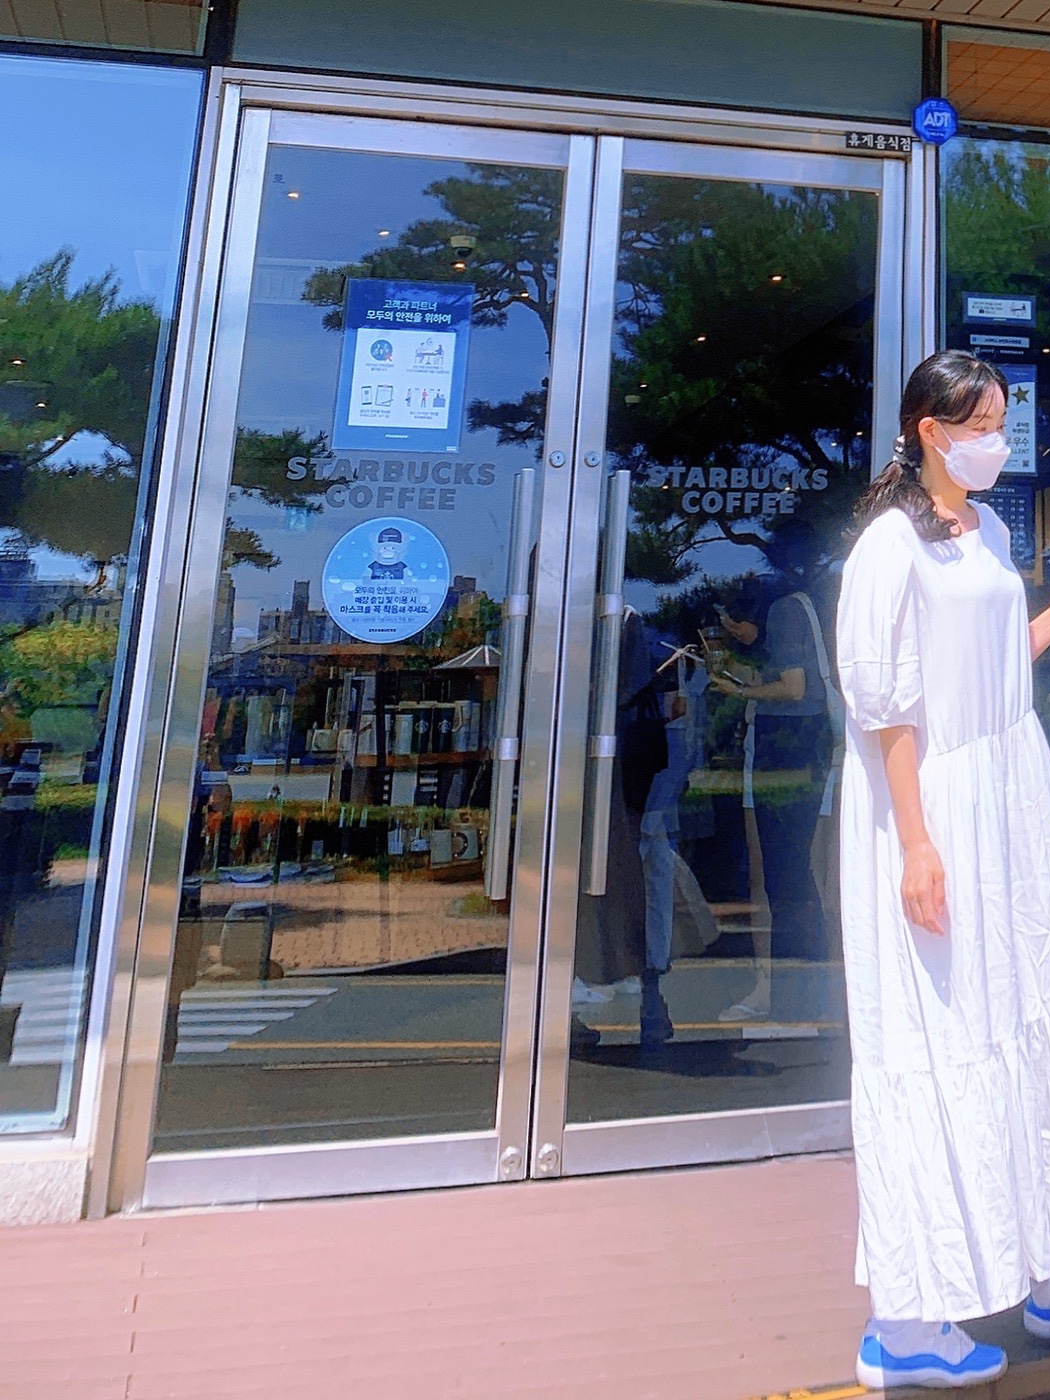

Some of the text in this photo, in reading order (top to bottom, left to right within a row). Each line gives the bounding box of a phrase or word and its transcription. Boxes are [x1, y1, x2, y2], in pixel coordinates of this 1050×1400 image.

[923, 111, 951, 127] ADT
[848, 132, 911, 151] 휴게음식점
[383, 299, 438, 312] 고객과 파트너
[366, 310, 452, 324] 모두의 안전을 위하여
[286, 456, 496, 486] STARBUCKS
[649, 466, 829, 491] STARBUCKS
[325, 484, 457, 511] COFFEE
[681, 490, 796, 514] COFFEE
[355, 586, 374, 595] 모두의
[409, 596, 417, 604] 시
[340, 605, 371, 614] 마스크를
